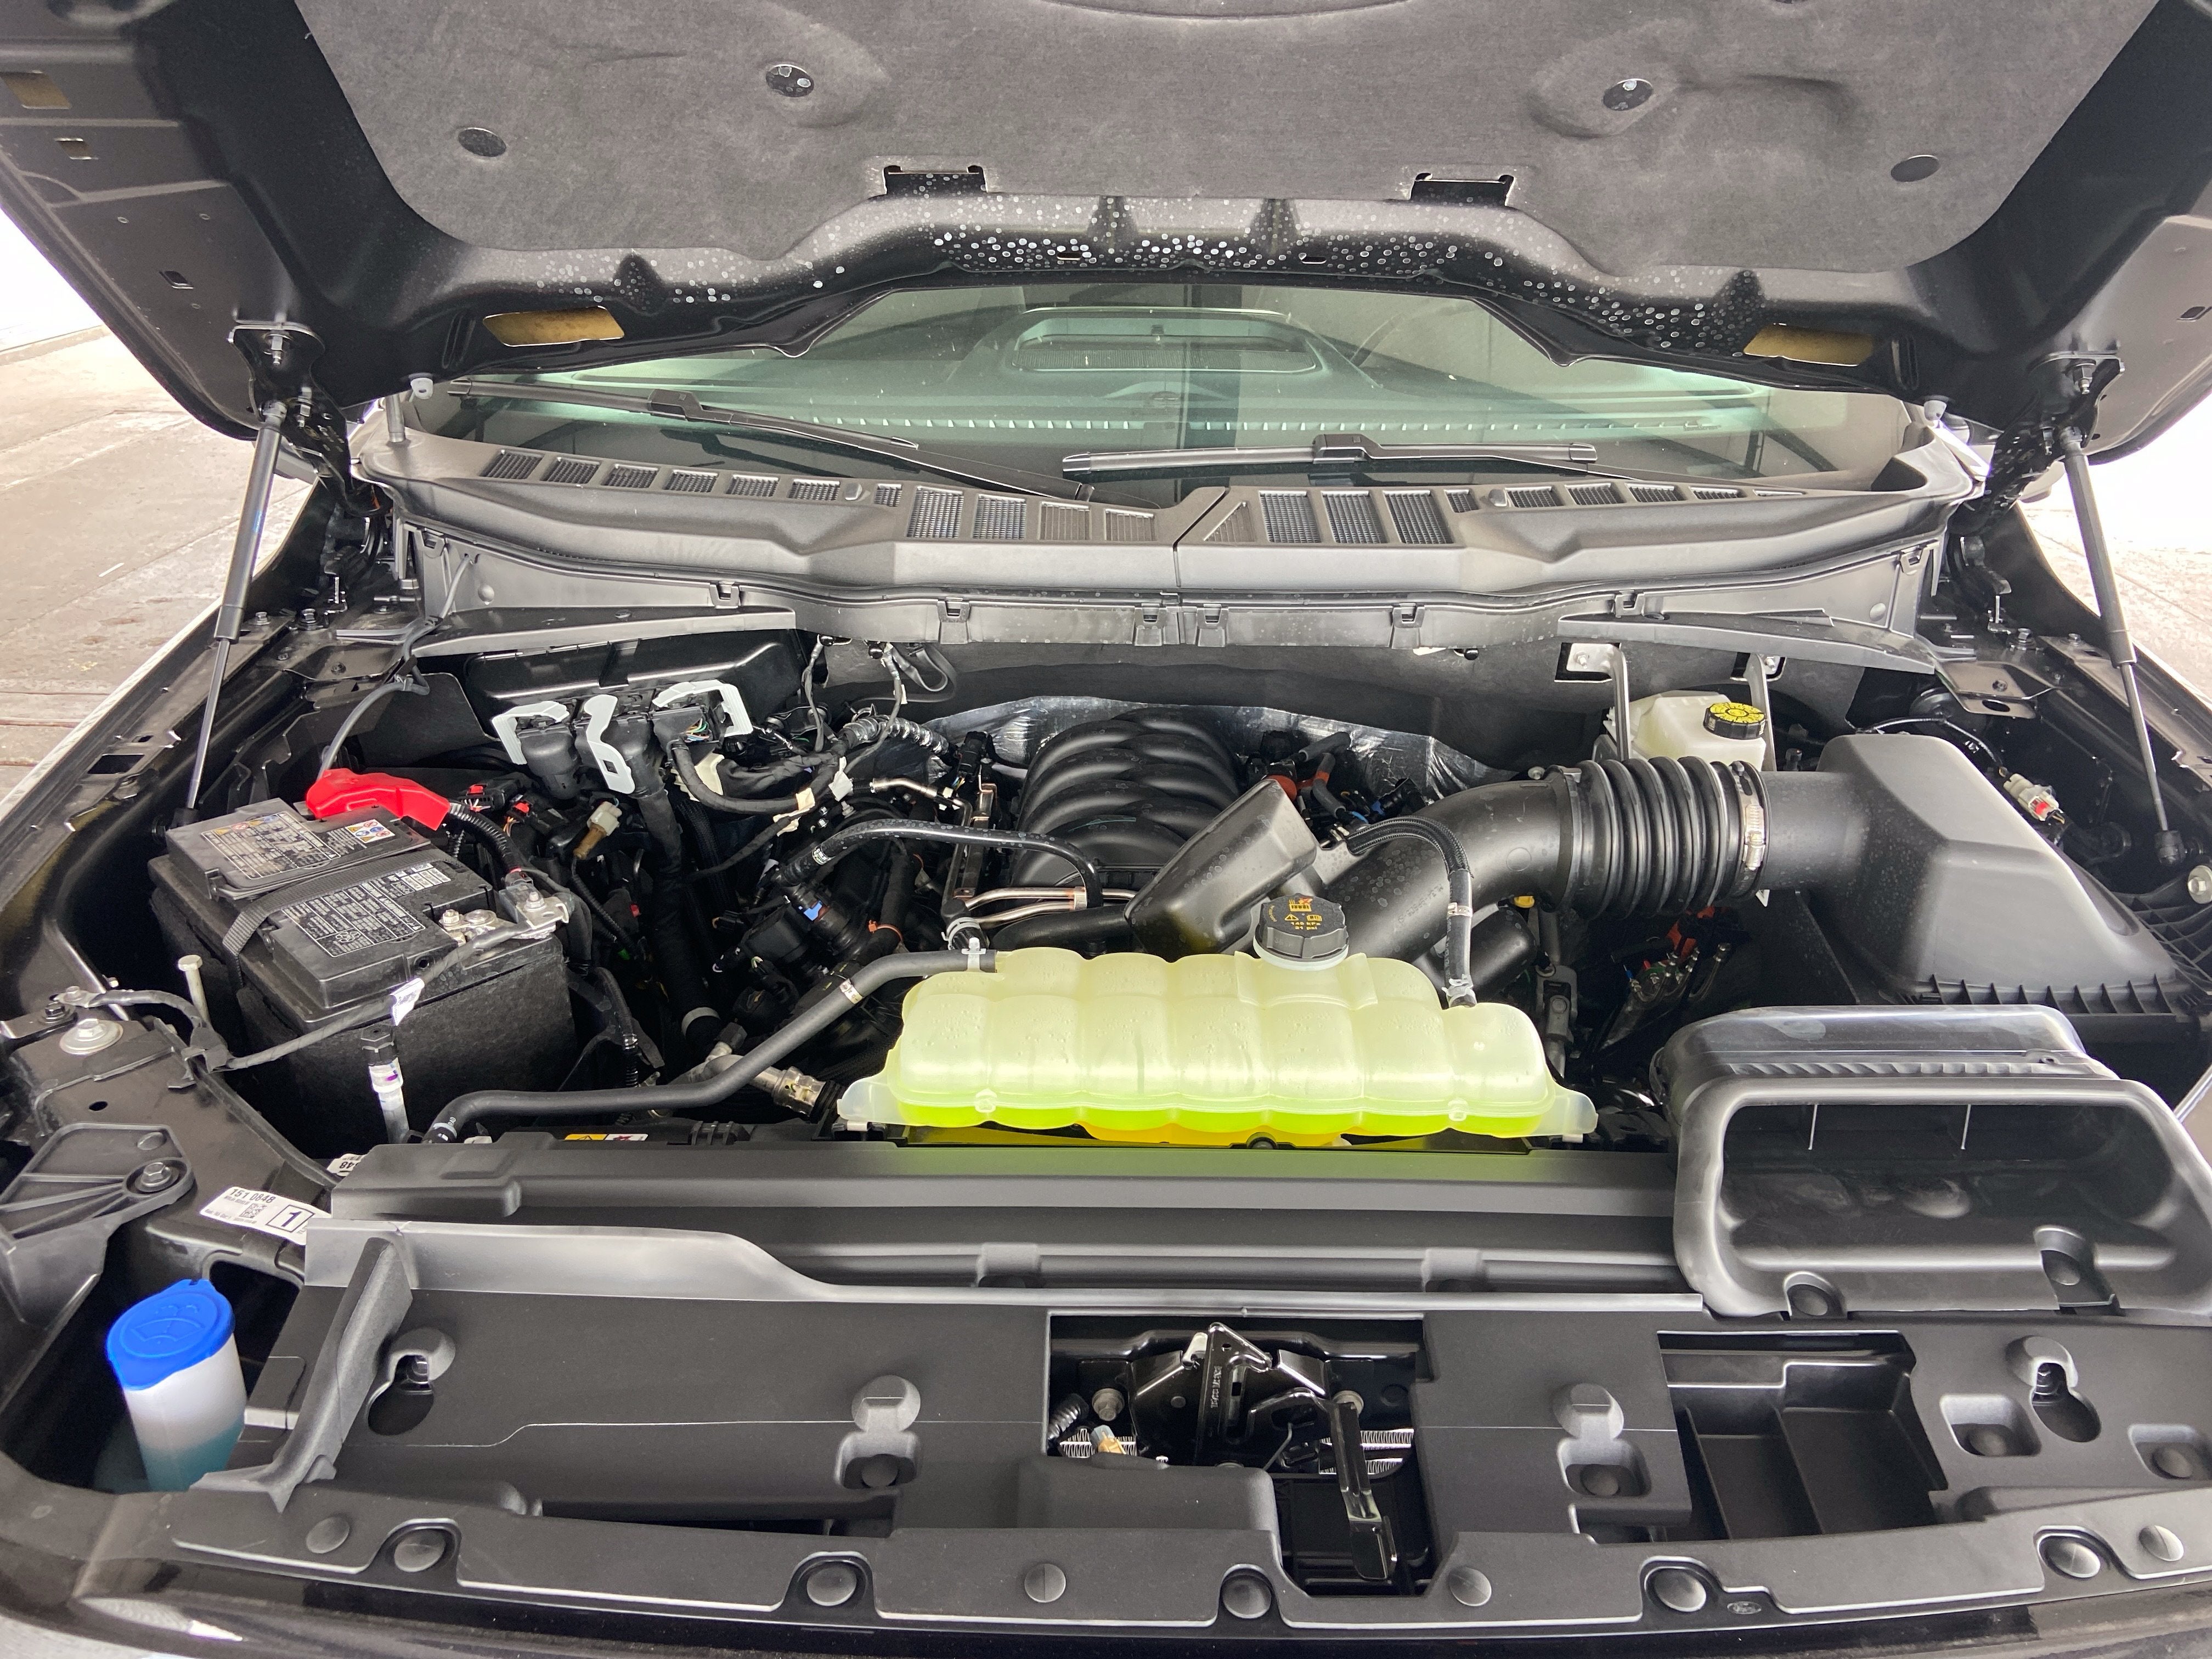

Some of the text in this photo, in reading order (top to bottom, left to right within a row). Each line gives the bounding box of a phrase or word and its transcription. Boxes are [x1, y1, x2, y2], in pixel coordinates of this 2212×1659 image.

[230, 1189, 250, 1199] 151
[250, 1193, 276, 1204] 0848
[281, 1211, 302, 1227] 1
